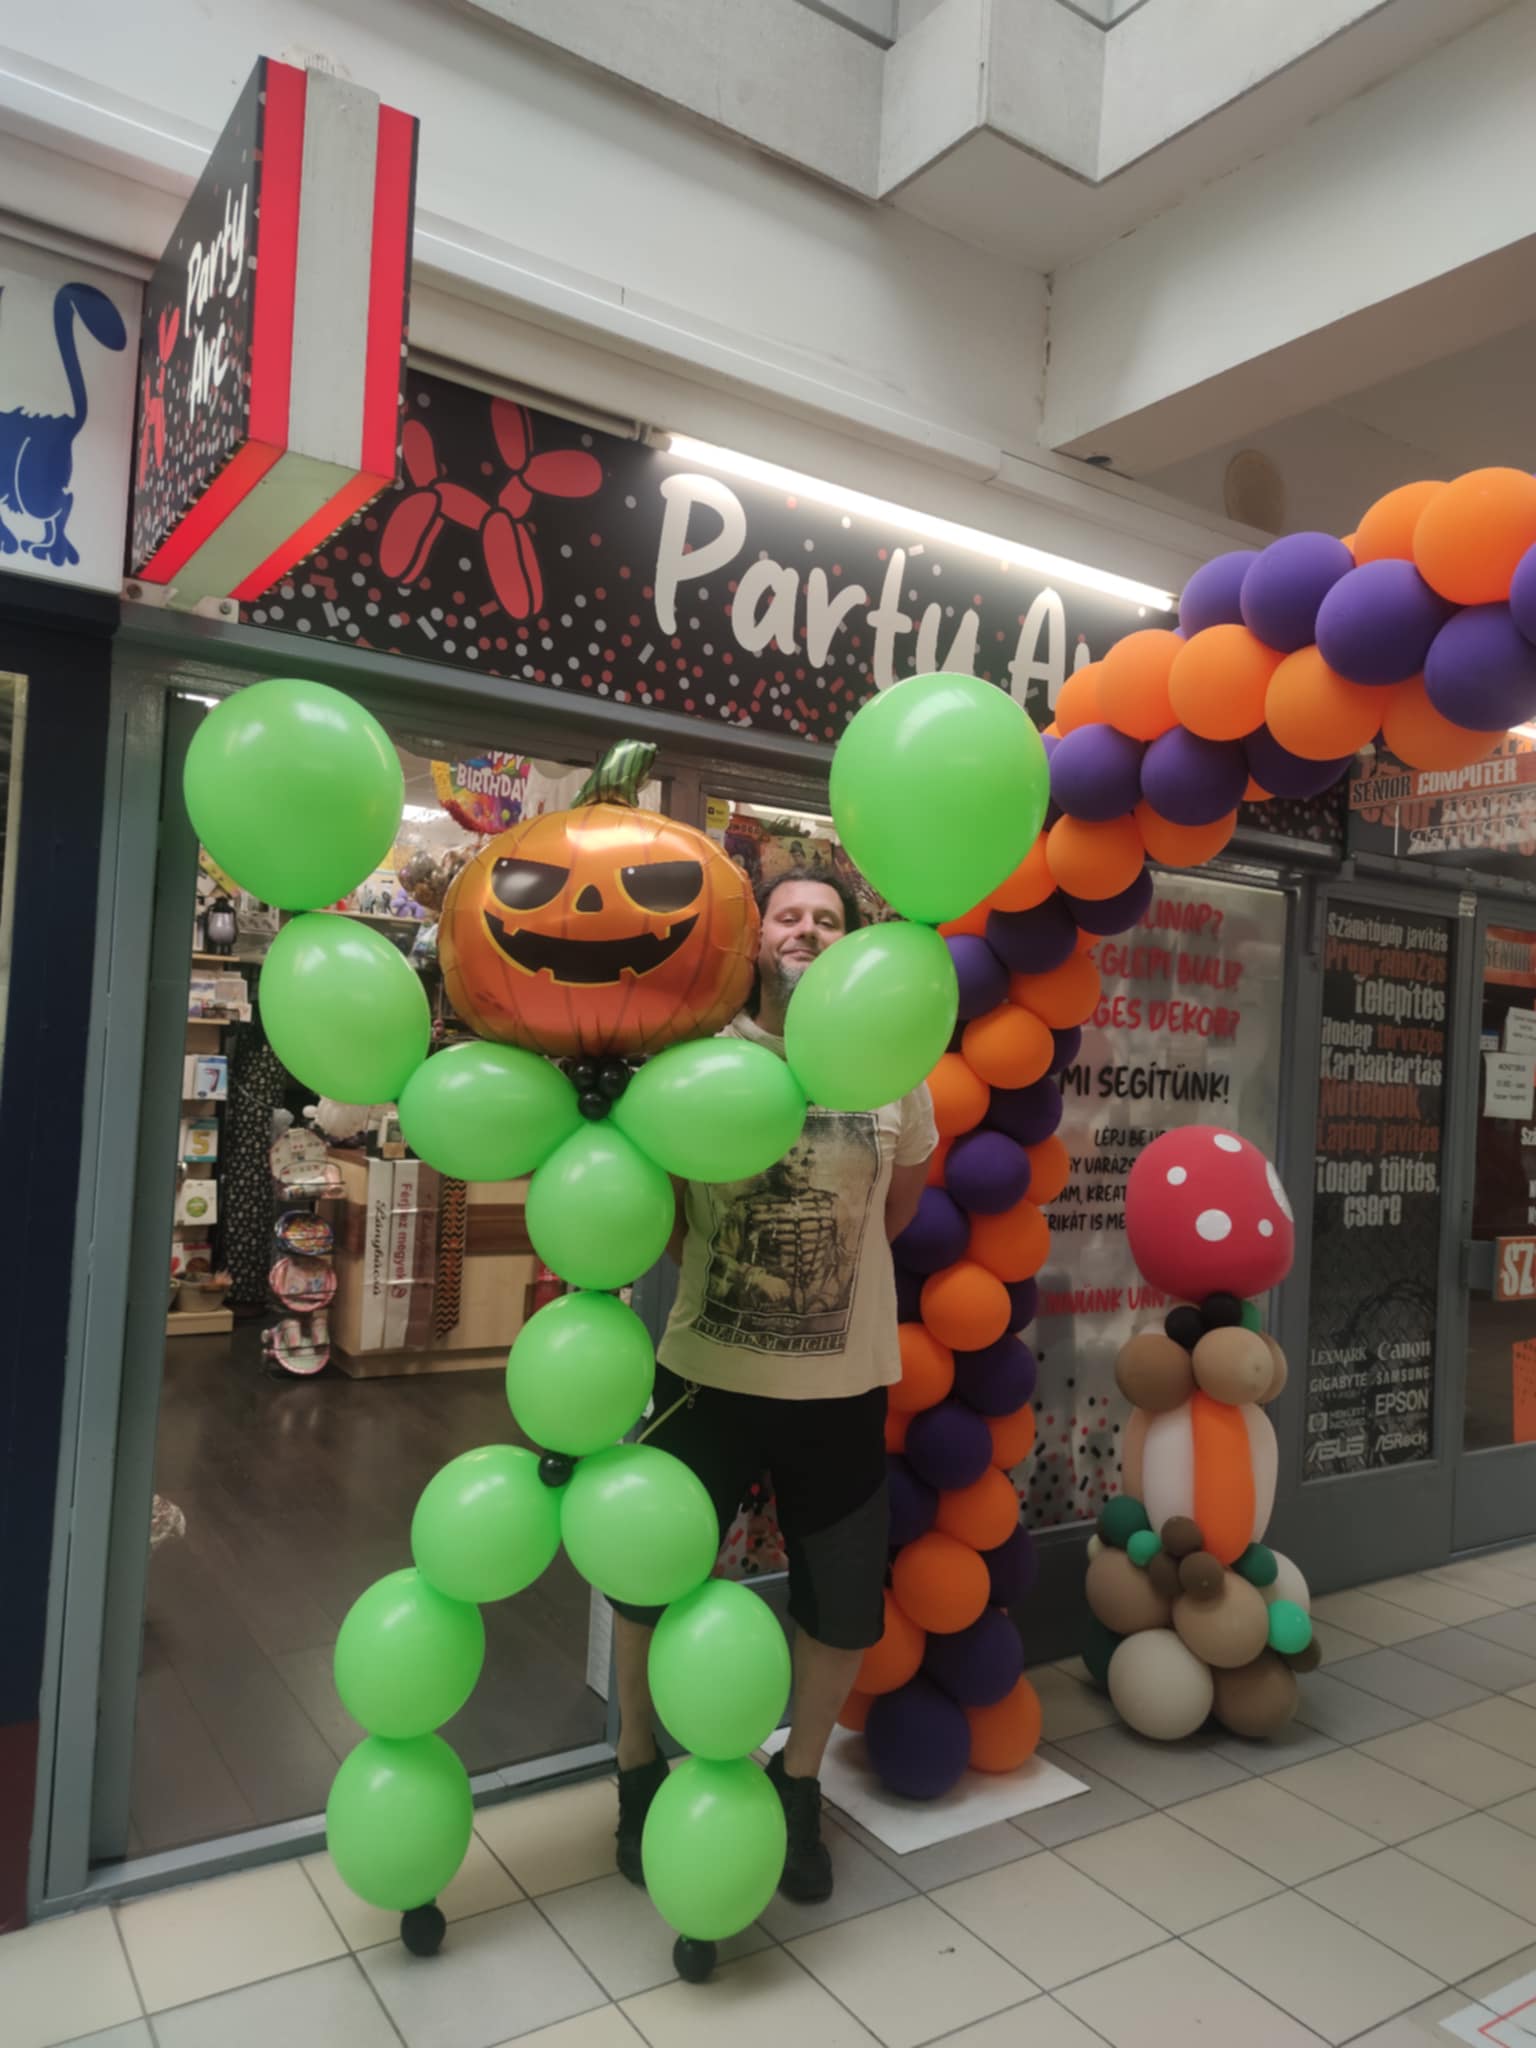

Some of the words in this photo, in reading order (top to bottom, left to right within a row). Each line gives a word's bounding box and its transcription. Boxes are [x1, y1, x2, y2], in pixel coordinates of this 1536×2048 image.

[185, 183, 248, 338] Party
[1008, 587, 1091, 711] A
[1353, 775, 1411, 804] SENIOR
[1417, 757, 1517, 796] COMPUTER
[1139, 899, 1224, 941] LINAP?
[1353, 974, 1445, 1024] Telepítés
[1149, 1000, 1241, 1041] DEKOR?
[1321, 1016, 1373, 1052] Honlap
[1060, 1064, 1091, 1097] MI
[1098, 1062, 1230, 1104] SEGÍTÜNK!
[1320, 1045, 1442, 1086] Karbantartás
[1320, 1076, 1421, 1120] Notebook
[191, 1131, 211, 1155] 5
[1316, 1119, 1377, 1156] Laptop
[1315, 1156, 1374, 1194] Toner
[1379, 1152, 1440, 1195] töltés,
[1090, 1213, 1103, 1231] IS
[1343, 1194, 1403, 1229] csere
[1311, 1347, 1367, 1367] LEXMARK
[1377, 1340, 1431, 1360] Canon
[1310, 1372, 1367, 1392] GIGABYTE
[1376, 1366, 1430, 1385] SAMSUNG
[1375, 1388, 1428, 1416] EPSON
